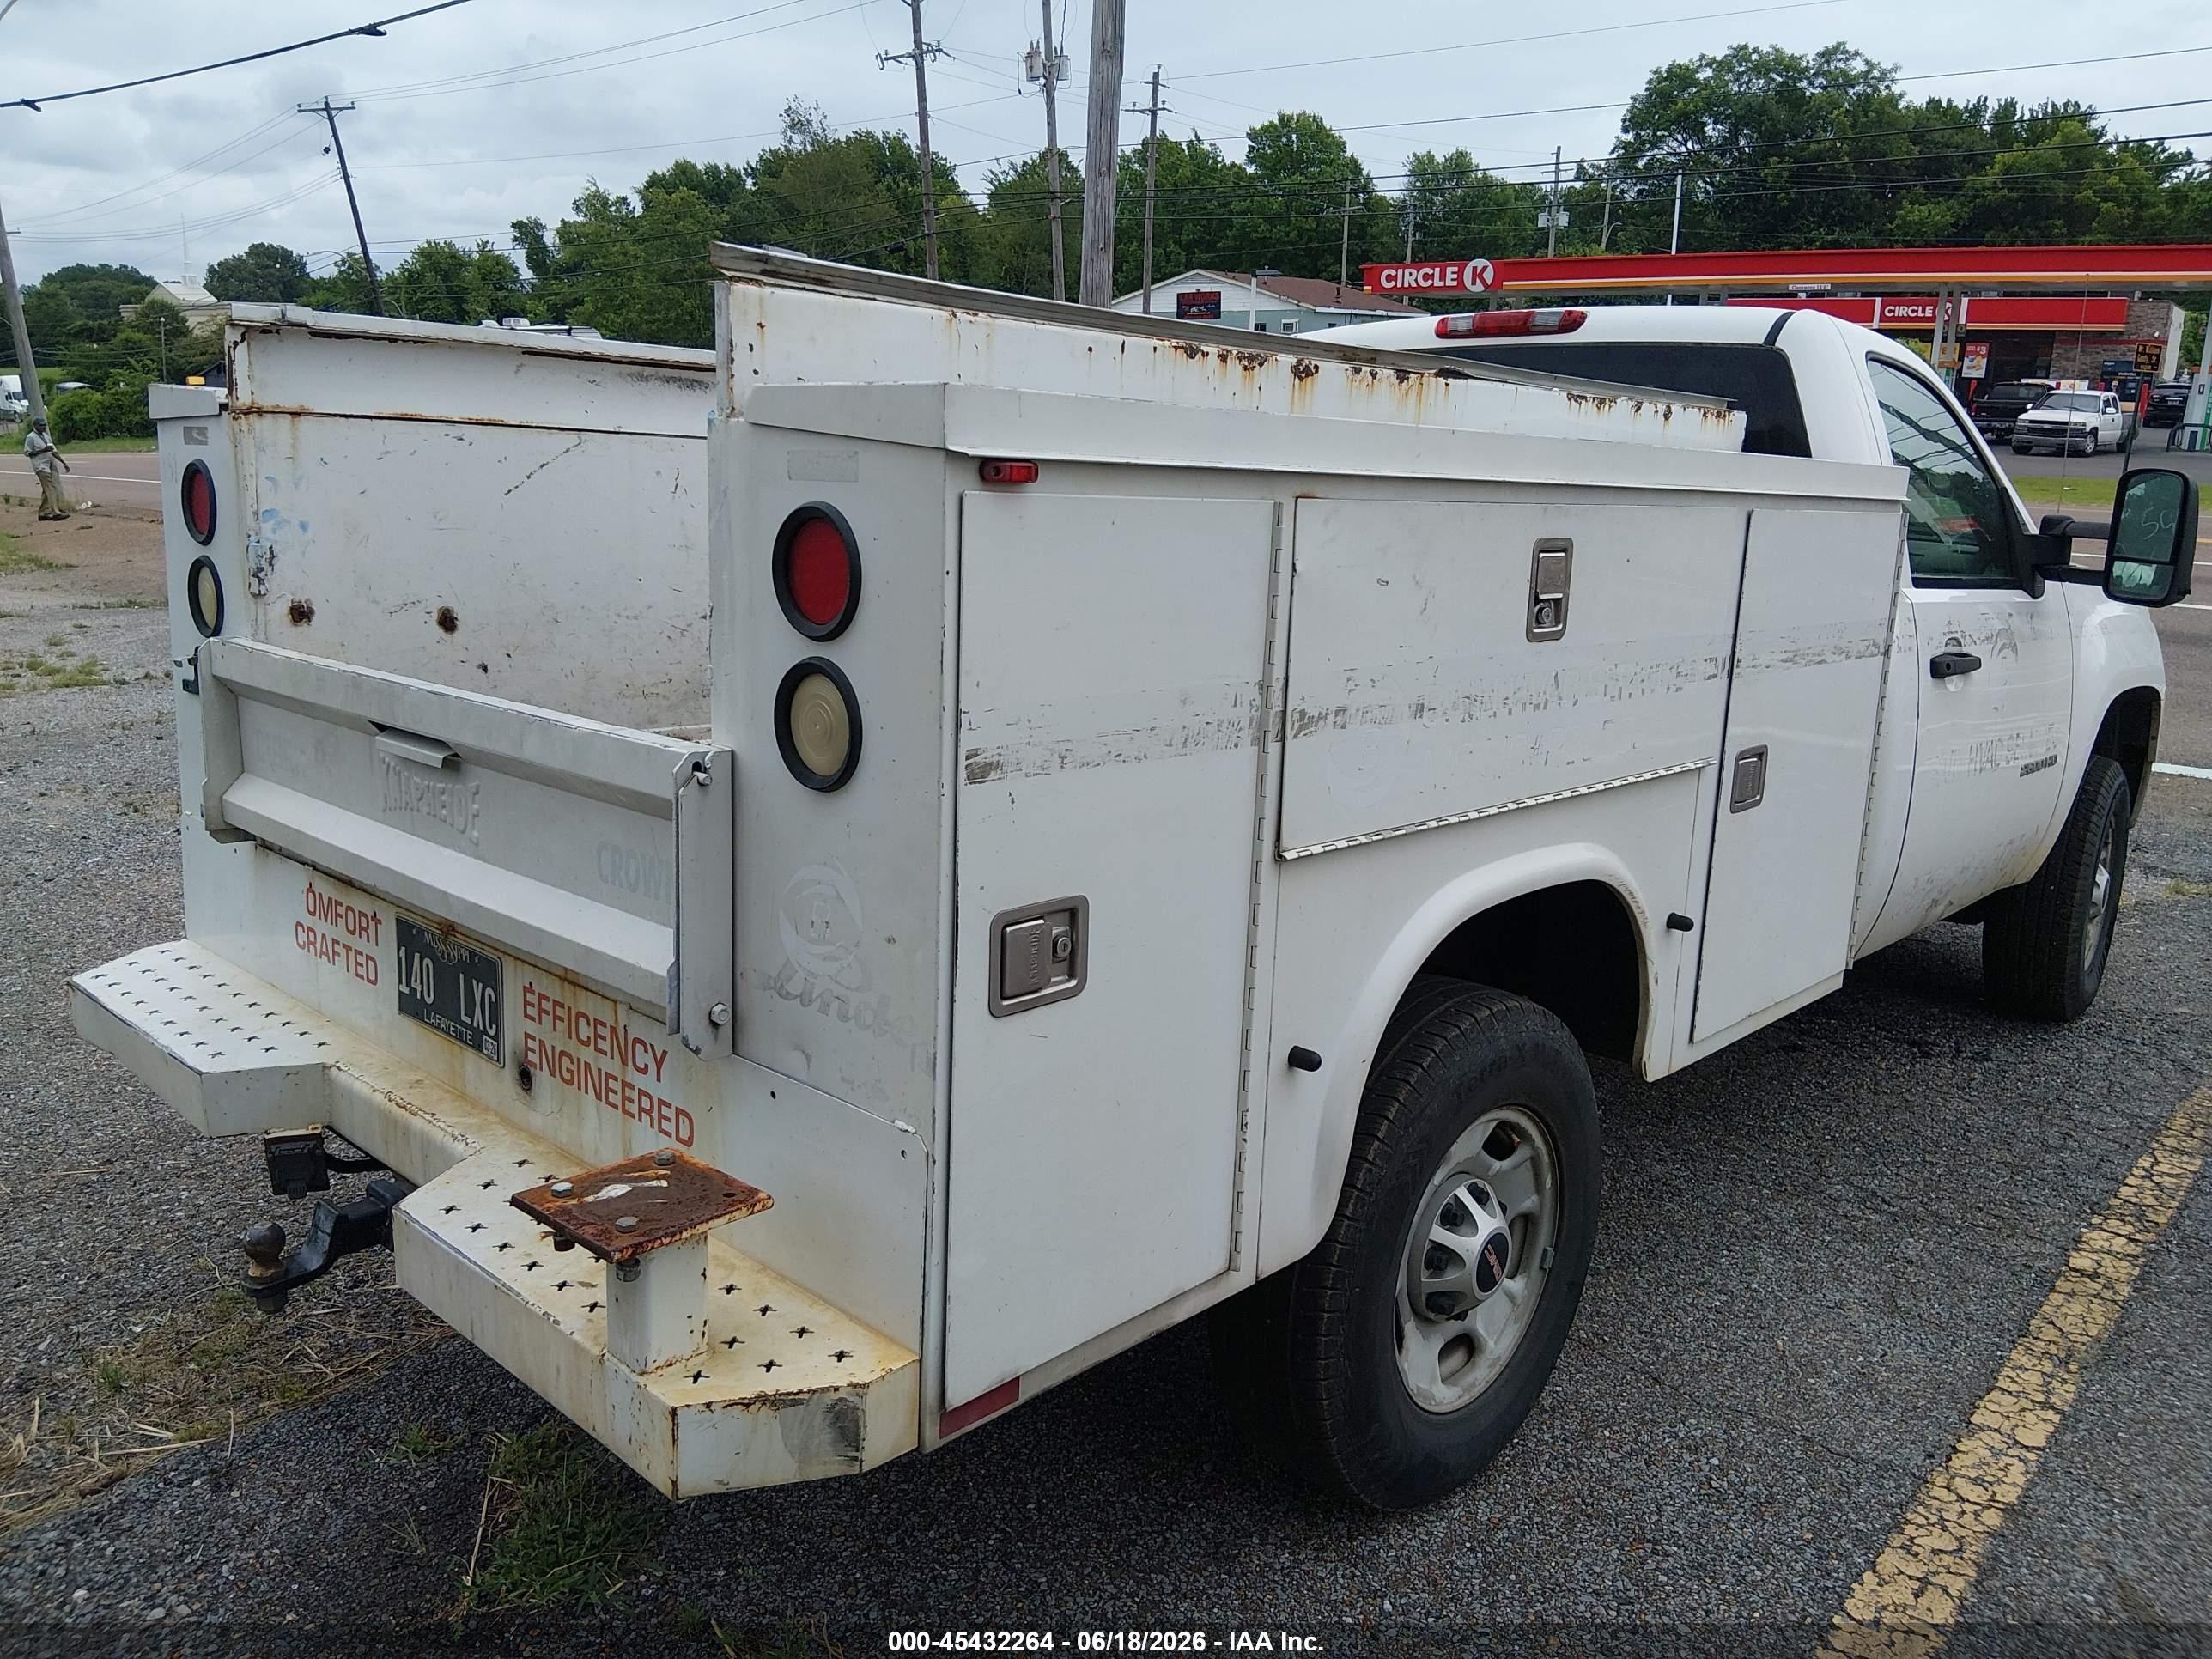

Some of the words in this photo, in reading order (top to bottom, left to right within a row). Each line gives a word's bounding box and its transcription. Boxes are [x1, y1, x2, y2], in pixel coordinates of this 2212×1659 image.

[1380, 266, 1458, 288] CIRCLE
[1470, 264, 1491, 291] K
[1884, 305, 1934, 317] CIRCLE
[295, 921, 379, 987] CRAFTED
[423, 932, 471, 965] MISSISSIPPI
[398, 946, 434, 1005] 140
[459, 972, 496, 1037] LXC
[424, 1009, 473, 1045] LAFAYETTE
[522, 985, 669, 1084] EFFICENCY
[522, 1031, 696, 1149] ENGINEERED
[1484, 1243, 1503, 1283] GMC
